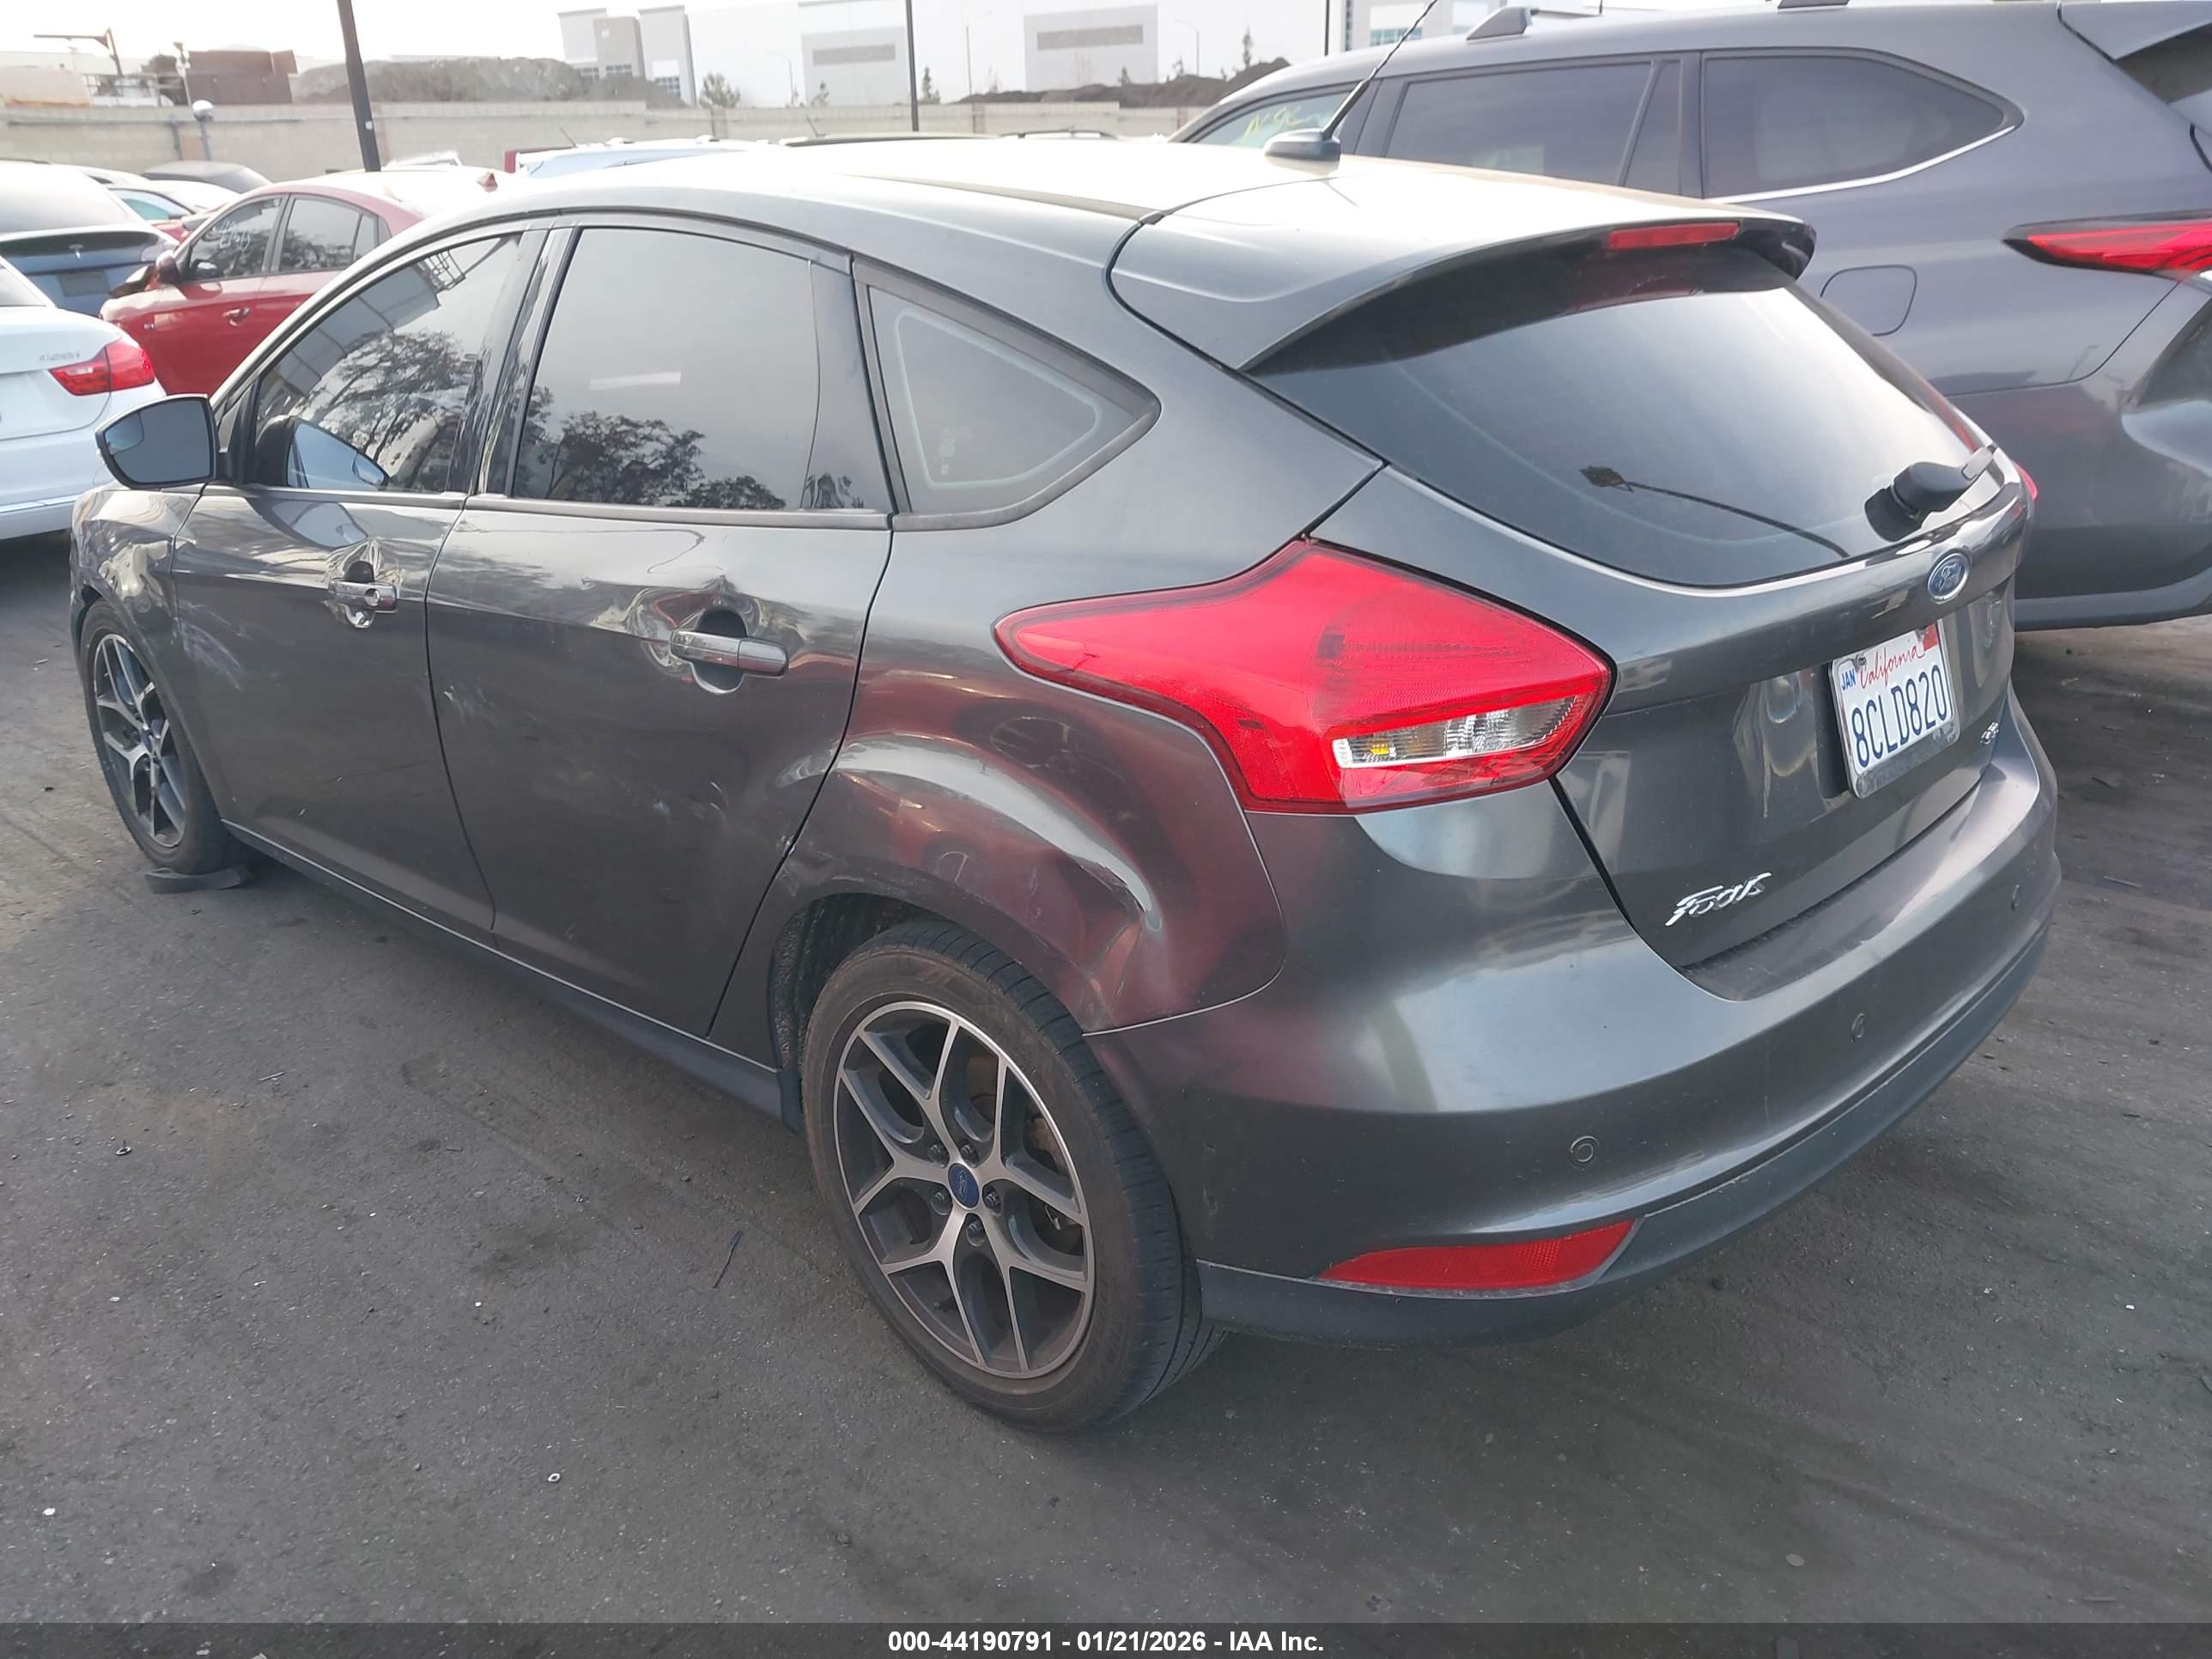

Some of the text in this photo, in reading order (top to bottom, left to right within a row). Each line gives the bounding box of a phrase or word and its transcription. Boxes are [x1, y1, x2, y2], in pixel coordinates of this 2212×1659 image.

[1841, 668, 1856, 690] JAN
[1860, 645, 1924, 689] California
[1851, 665, 1947, 768] 8CLD820
